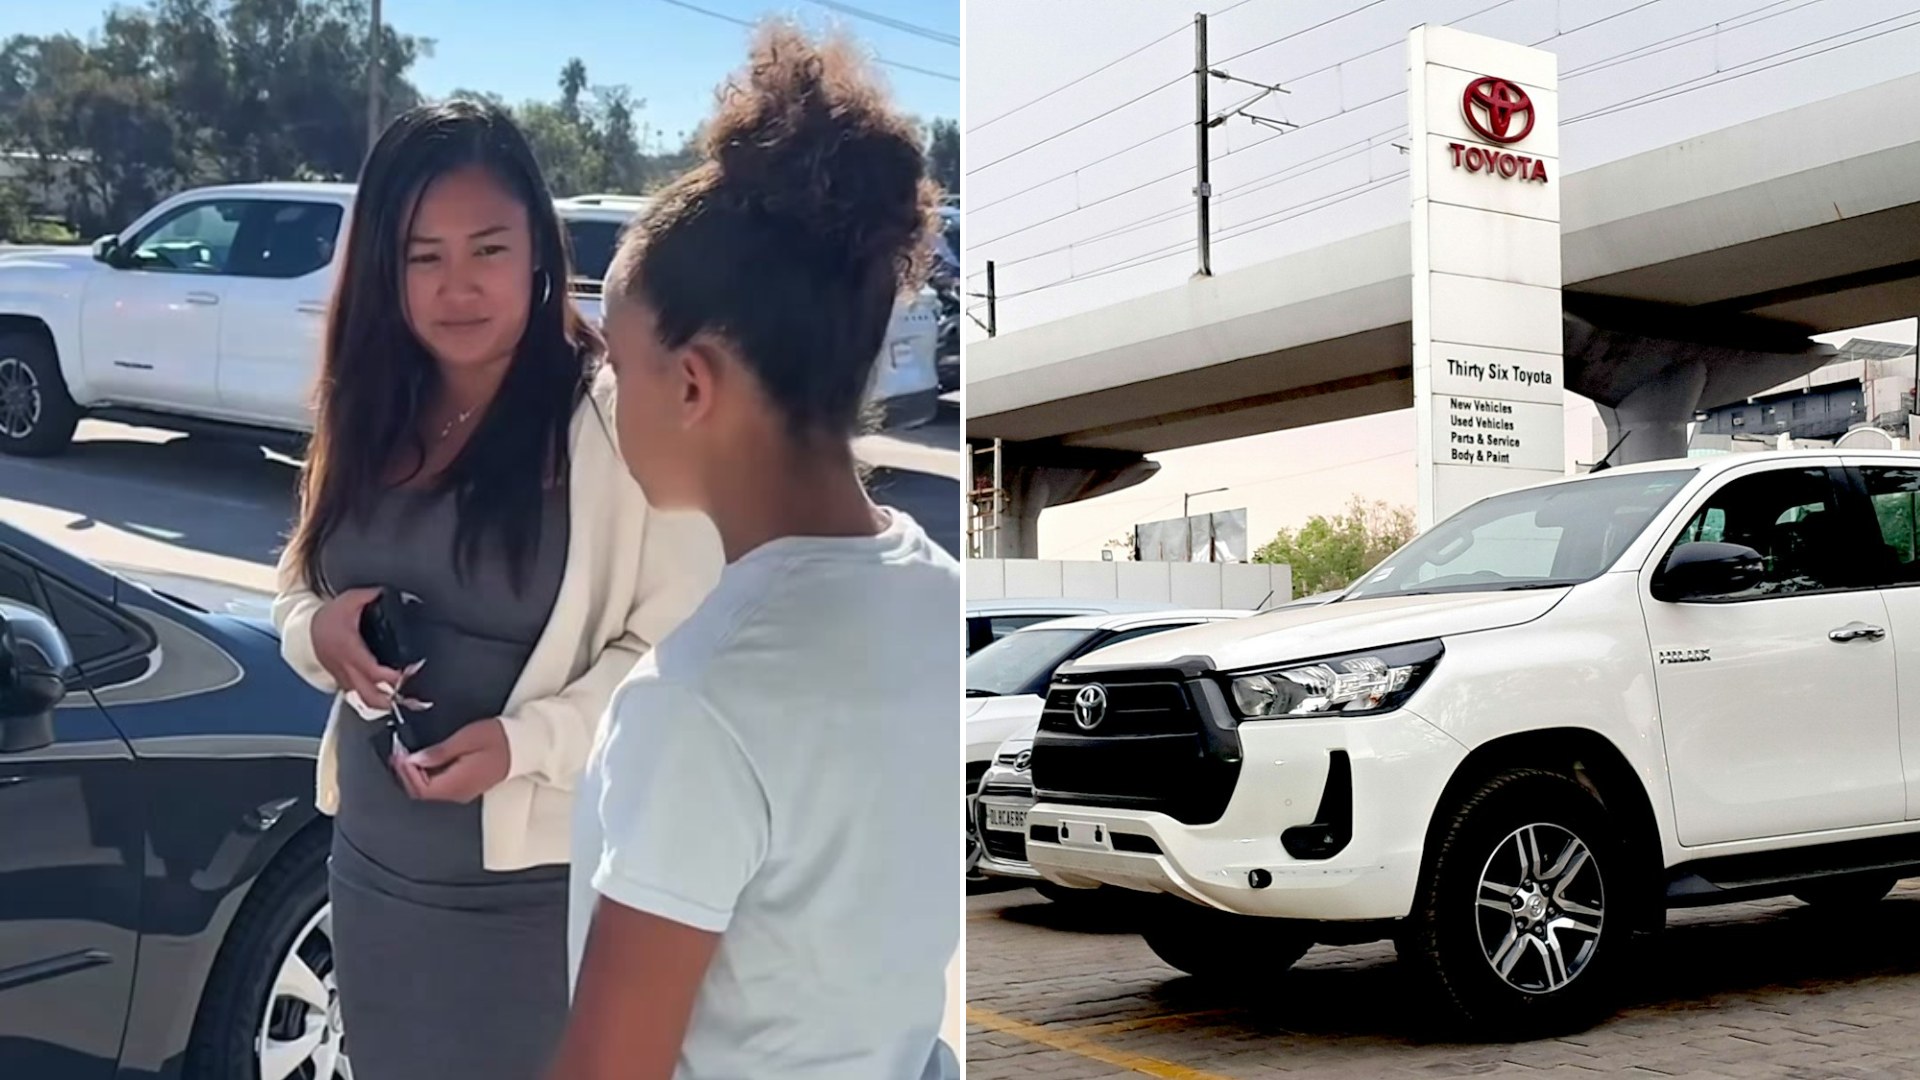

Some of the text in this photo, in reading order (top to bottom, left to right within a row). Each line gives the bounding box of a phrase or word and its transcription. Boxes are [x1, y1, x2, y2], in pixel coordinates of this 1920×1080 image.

[1448, 142, 1548, 184] TOYOTA
[1447, 359, 1552, 387] Thirty Six Toyota
[1450, 397, 1512, 414] New Vehicles
[1450, 414, 1514, 431] Used Vehicles
[1450, 431, 1520, 448] Parts & Service
[1451, 448, 1510, 464] Body & Paint
[1659, 649, 1711, 665] HILUX
